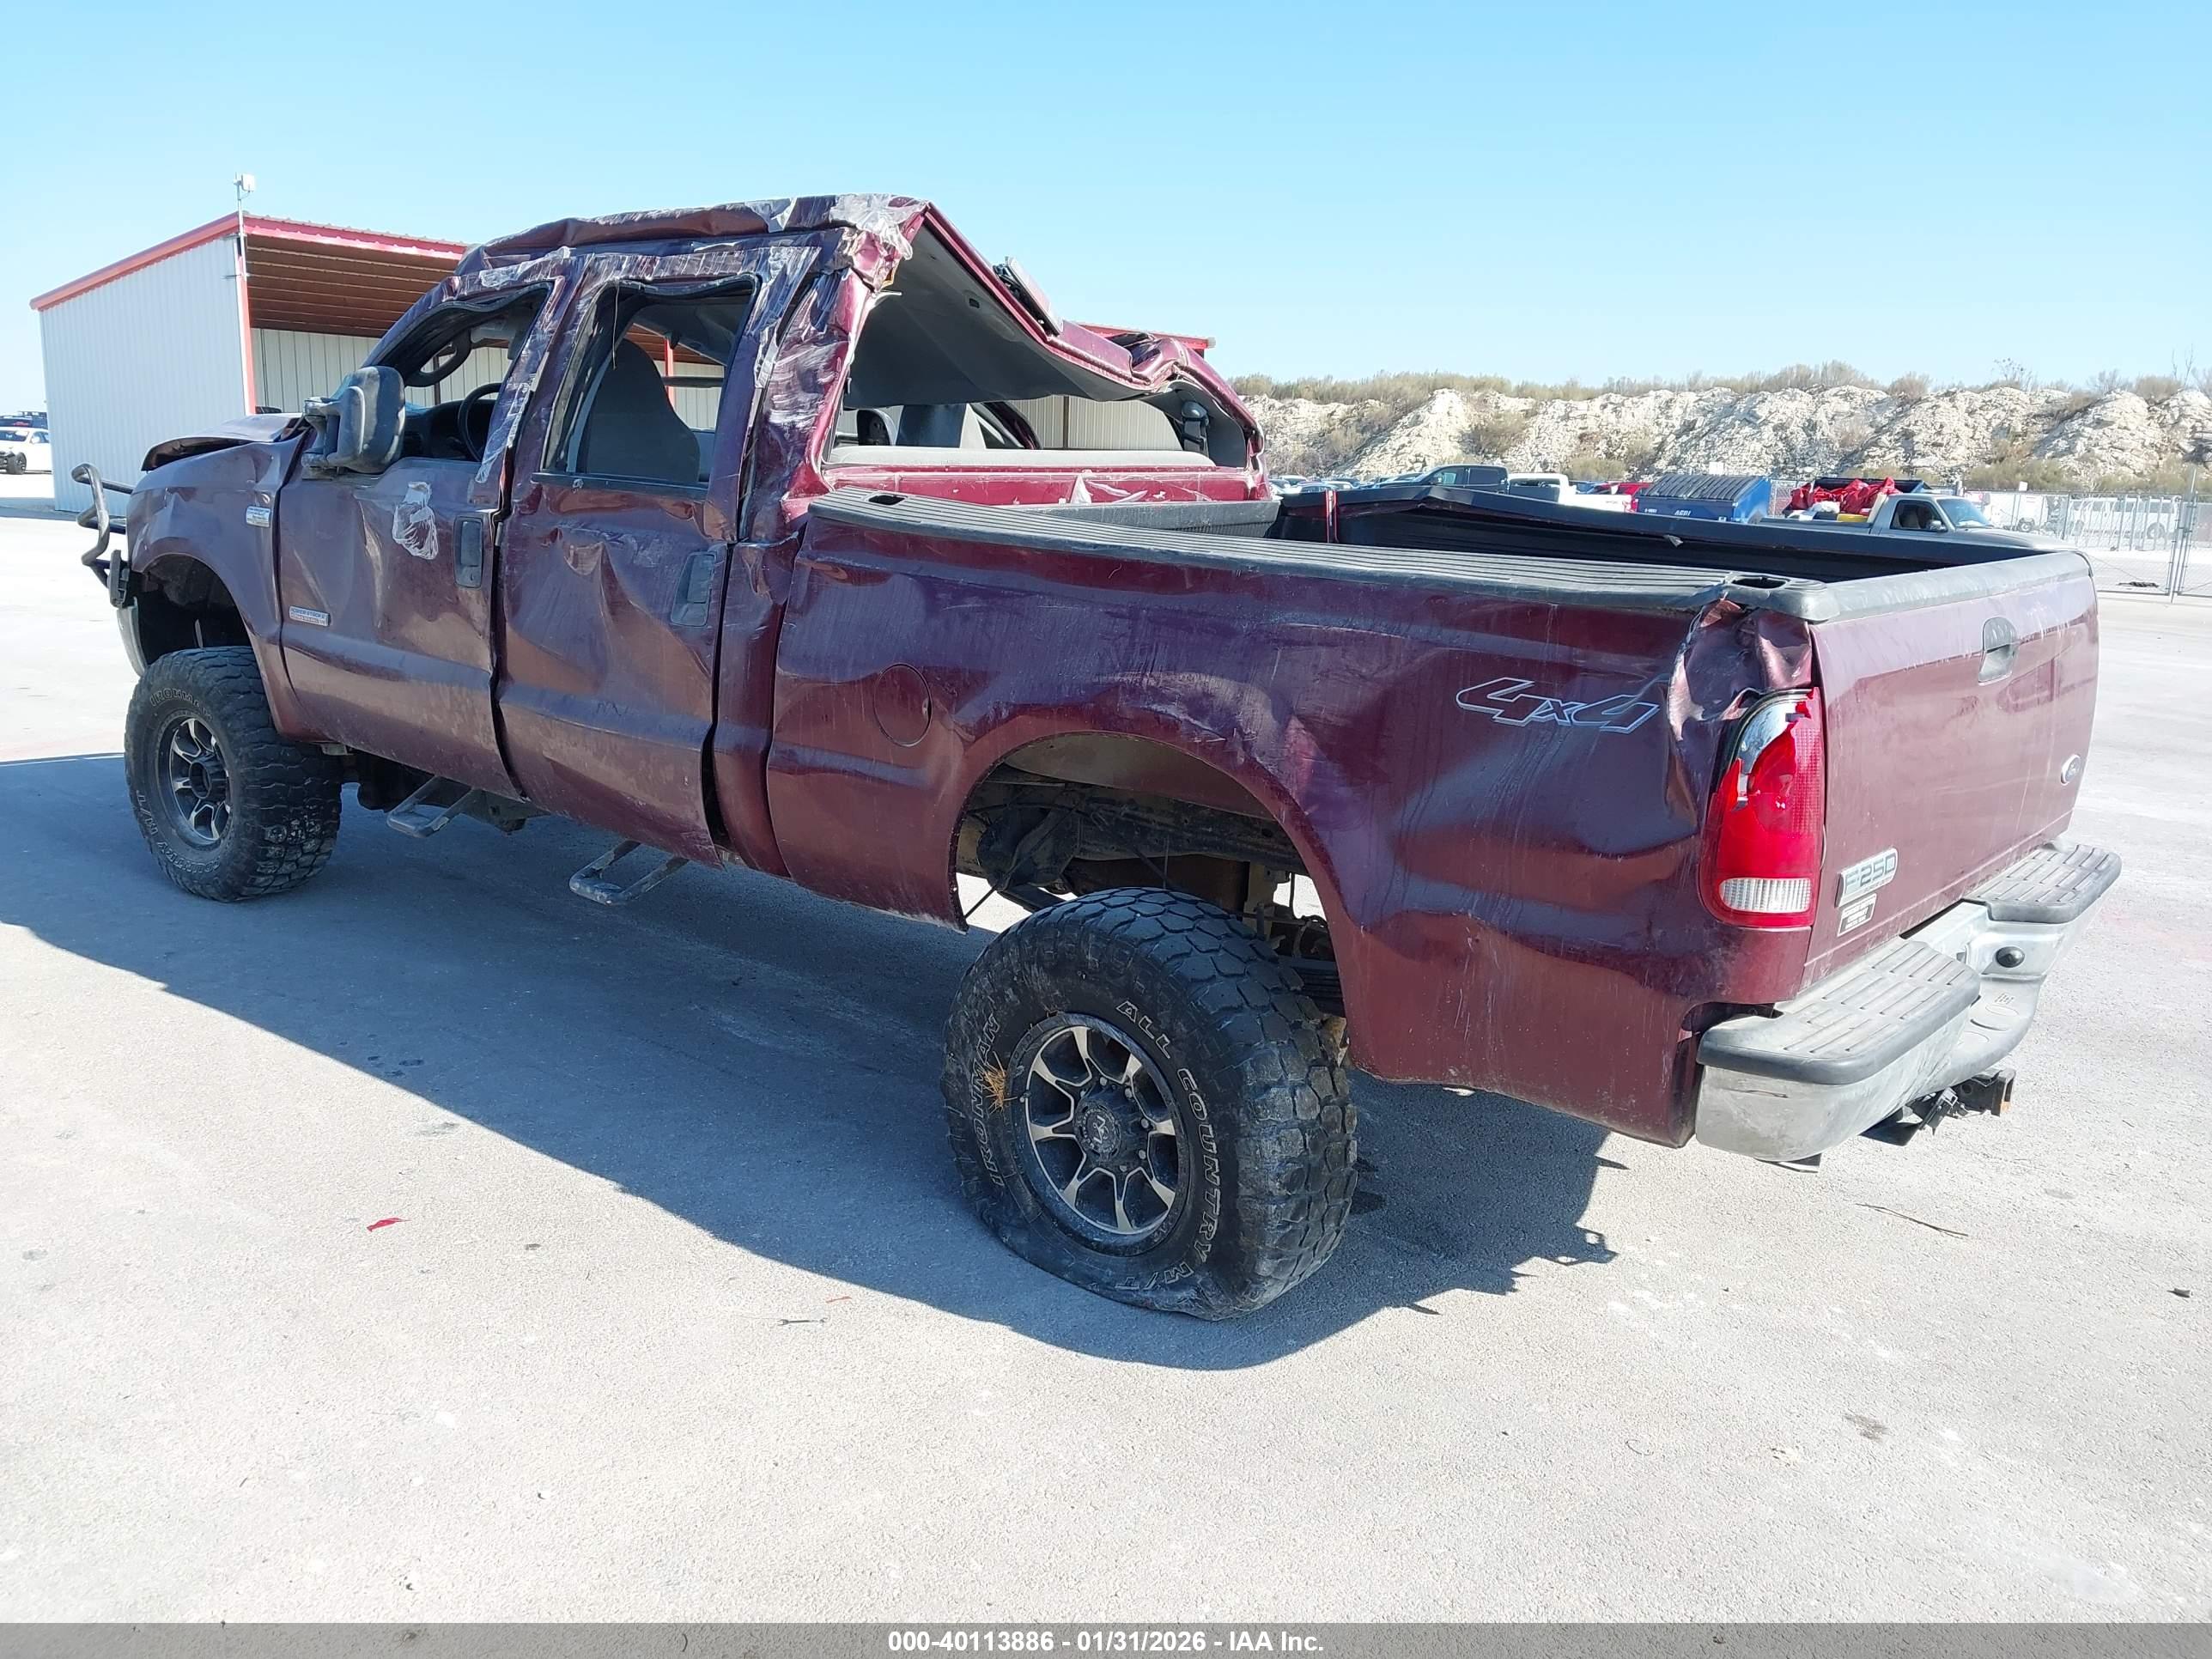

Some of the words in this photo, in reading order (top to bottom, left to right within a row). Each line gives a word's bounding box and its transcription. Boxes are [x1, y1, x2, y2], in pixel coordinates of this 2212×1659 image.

[1455, 676, 1661, 734] 4x4
[1116, 1000, 1173, 1059] ALL
[970, 1012, 1005, 1187] IRONMAN
[1177, 1067, 1222, 1263] COUNTRY
[1115, 1261, 1194, 1291] M/T
